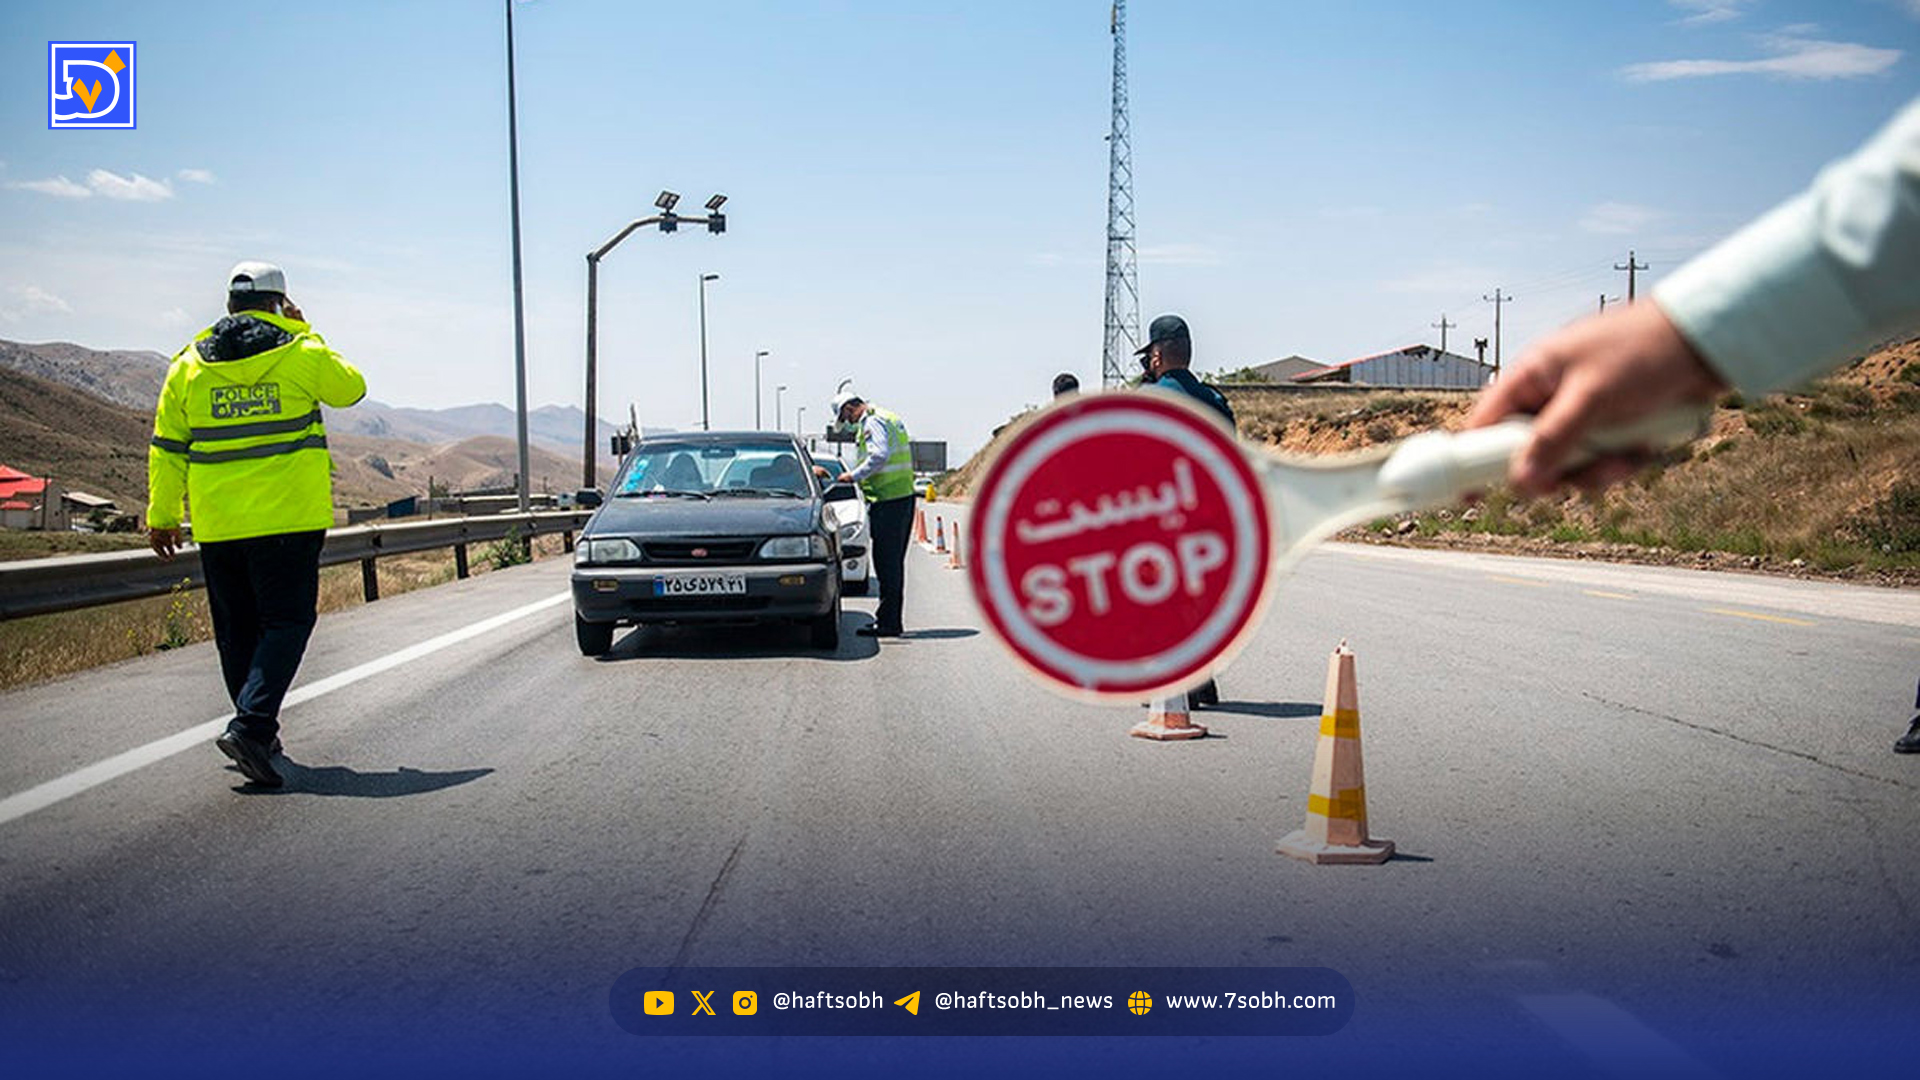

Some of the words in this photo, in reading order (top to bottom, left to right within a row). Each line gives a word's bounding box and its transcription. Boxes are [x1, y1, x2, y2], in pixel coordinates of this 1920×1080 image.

[214, 385, 278, 402] POLICE
[1016, 457, 1198, 544] ایست
[1021, 531, 1228, 626] STOP
